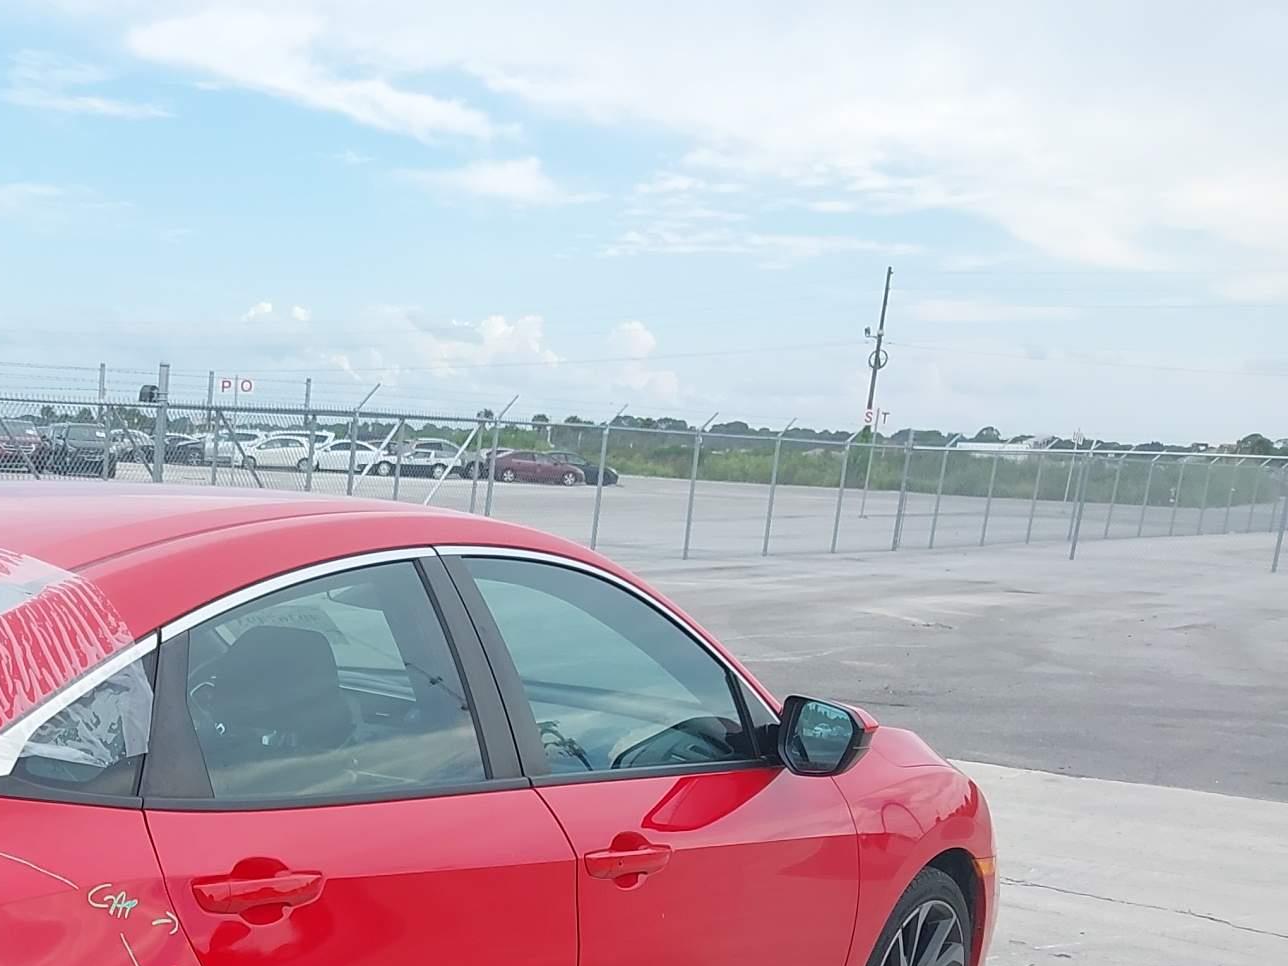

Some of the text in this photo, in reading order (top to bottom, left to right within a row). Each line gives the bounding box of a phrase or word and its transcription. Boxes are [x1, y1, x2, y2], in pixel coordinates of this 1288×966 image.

[221, 379, 232, 393] P
[864, 411, 891, 425] S T
